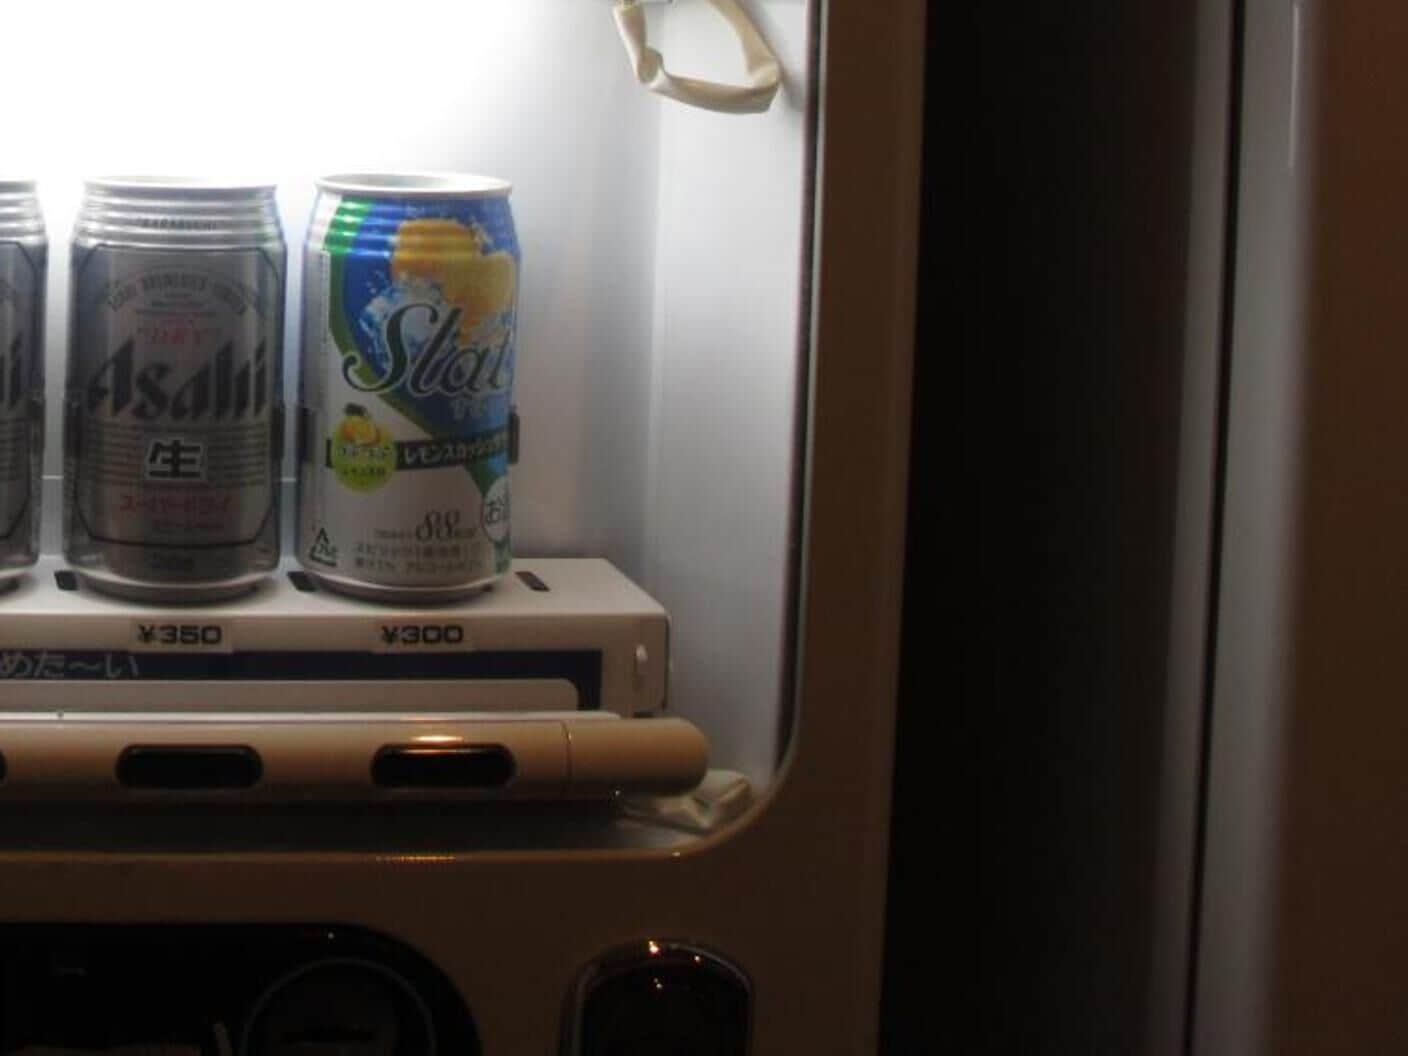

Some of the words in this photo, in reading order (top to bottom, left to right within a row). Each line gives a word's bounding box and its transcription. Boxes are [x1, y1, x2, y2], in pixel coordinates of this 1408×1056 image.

[342, 302, 512, 395] Slat
[88, 338, 267, 420] Asahi
[148, 439, 202, 479] 生
[137, 623, 223, 646] ¥350
[381, 623, 465, 646] ¥300
